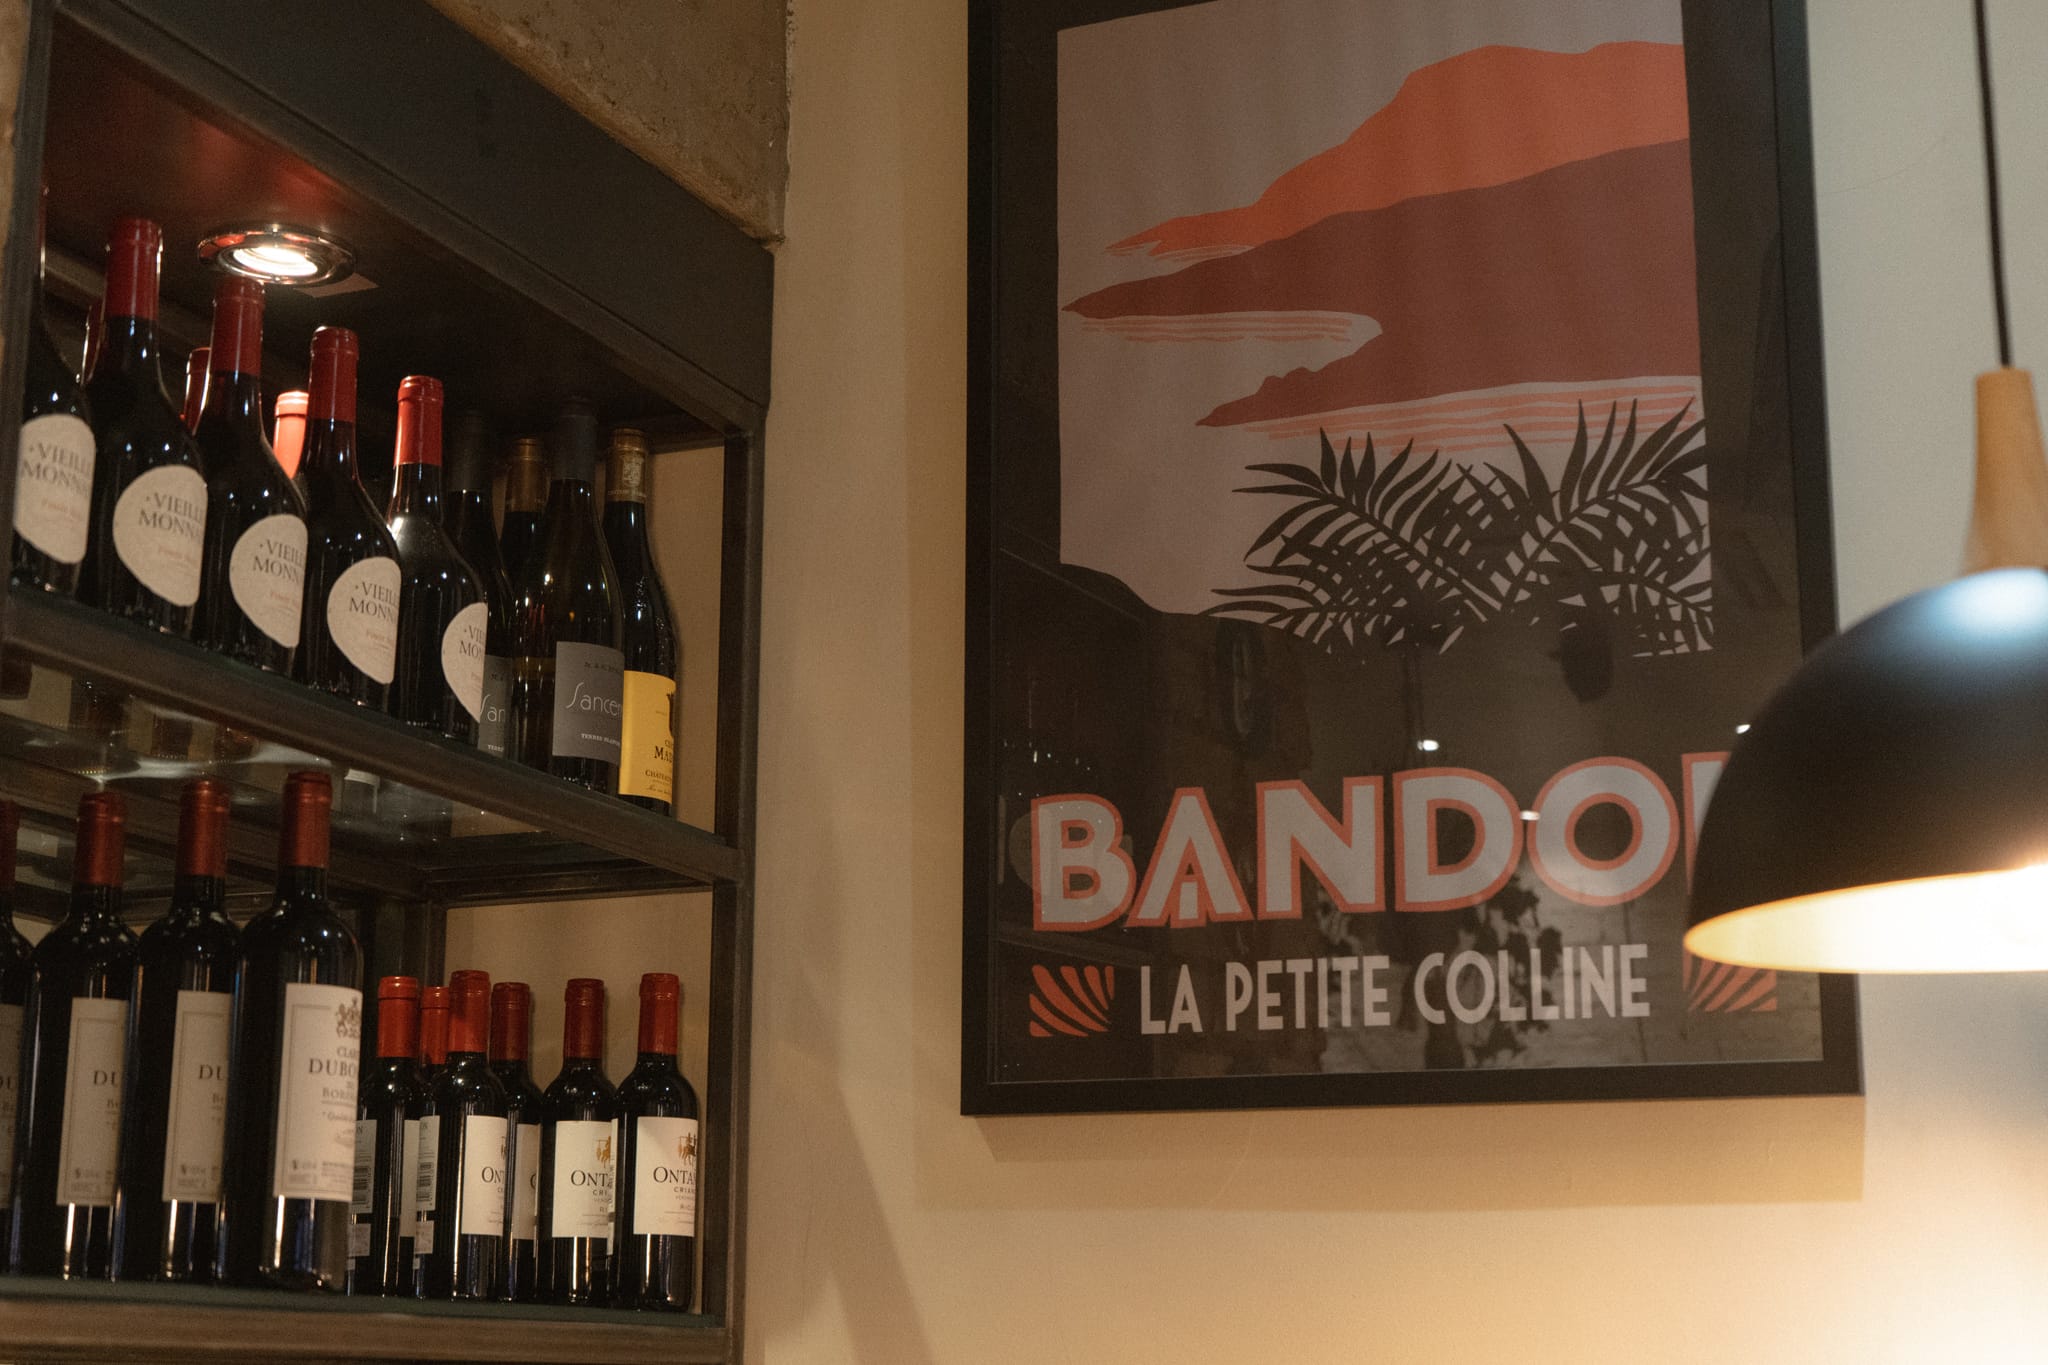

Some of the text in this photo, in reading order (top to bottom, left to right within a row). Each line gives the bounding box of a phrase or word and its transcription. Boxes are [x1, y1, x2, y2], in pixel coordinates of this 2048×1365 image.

[1140, 943, 1650, 1035] LA PETITE COLLINE
